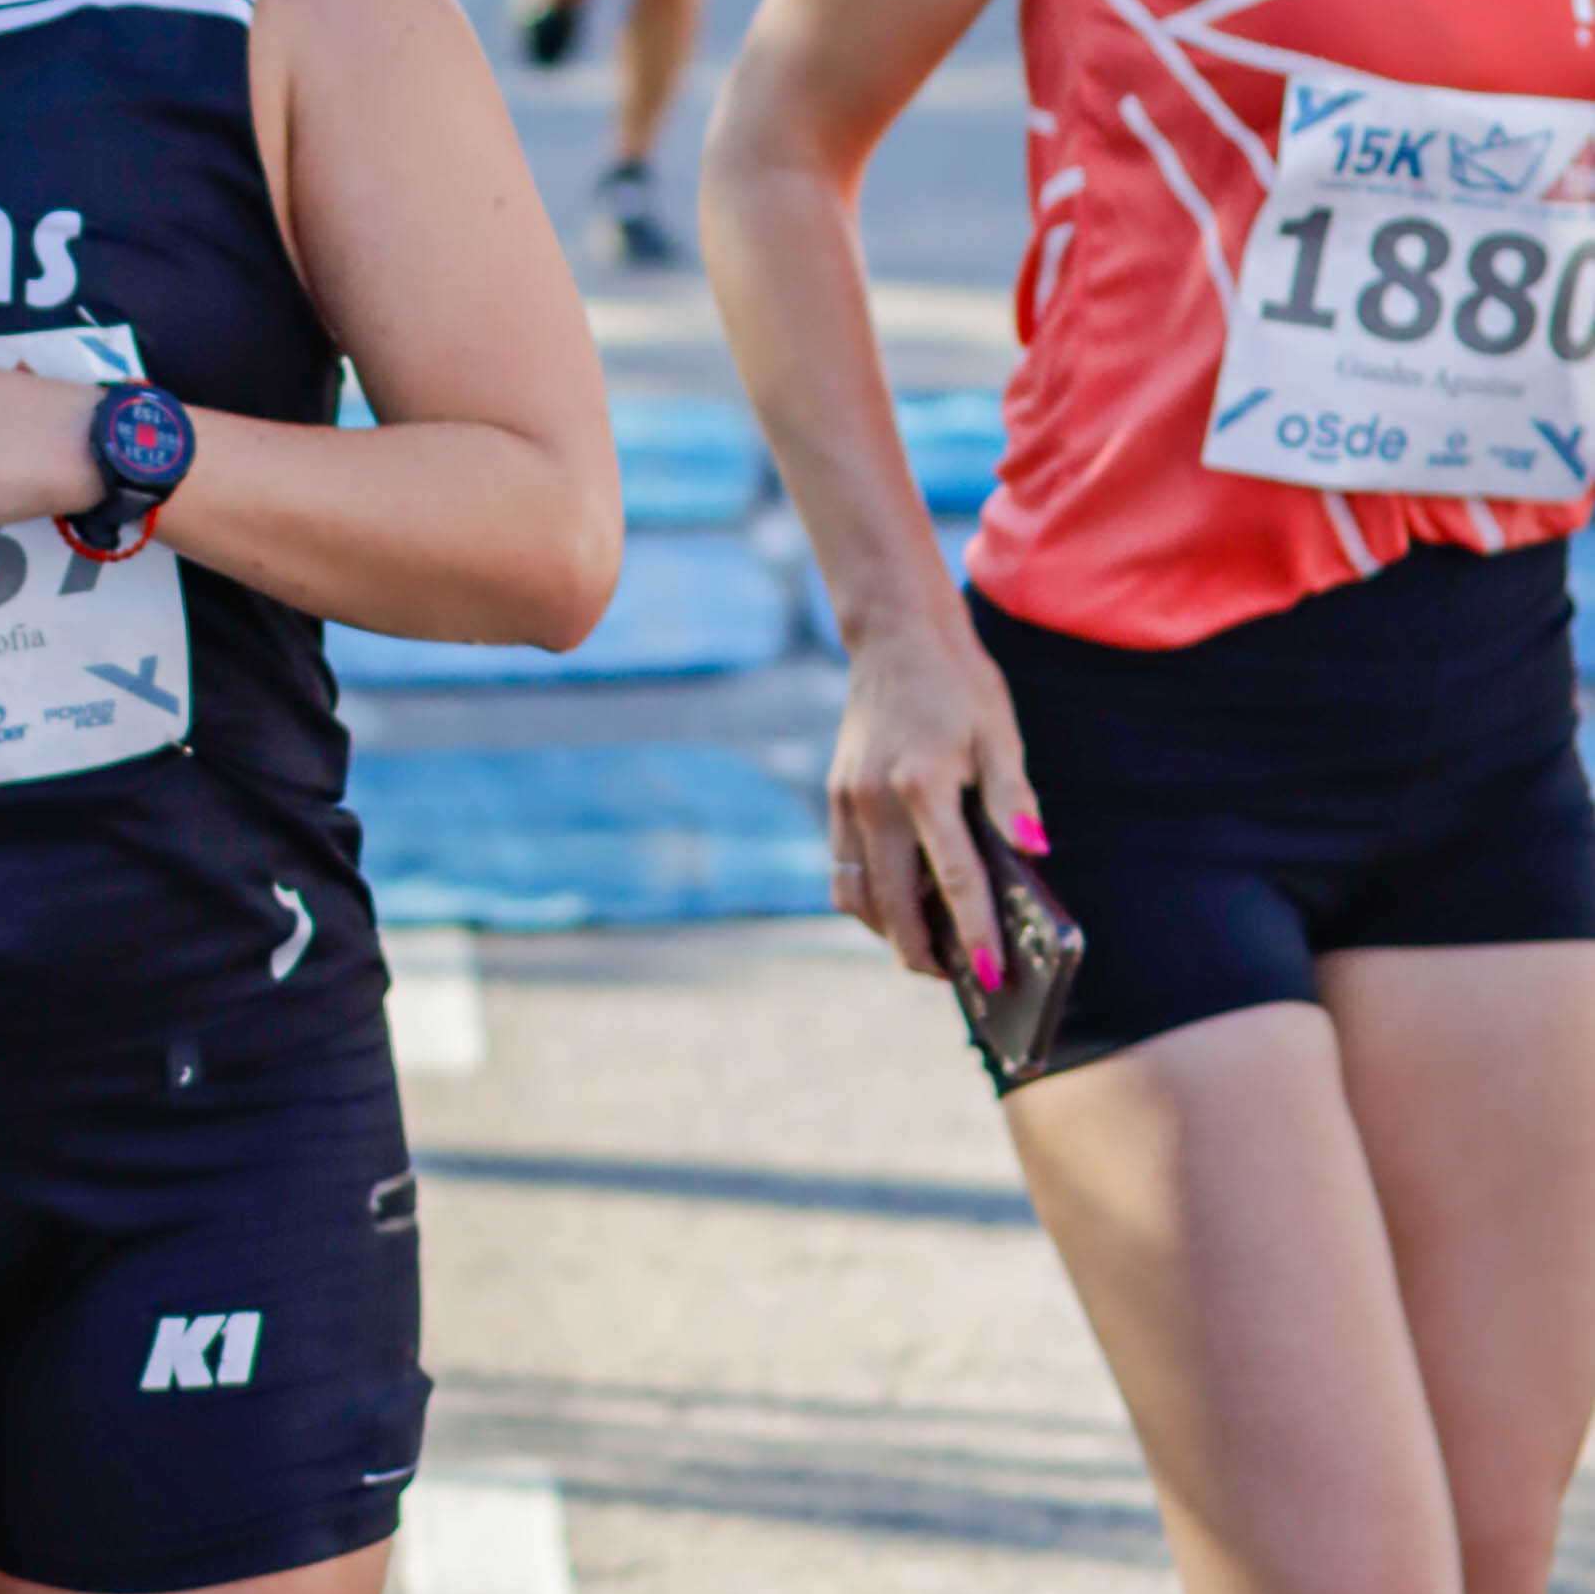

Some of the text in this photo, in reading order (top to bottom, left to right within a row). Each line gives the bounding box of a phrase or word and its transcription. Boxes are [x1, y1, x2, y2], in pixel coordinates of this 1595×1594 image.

[1332, 122, 1438, 180] 15K
[1260, 206, 1595, 361] 1880
[1277, 412, 1408, 462] osde
[139, 1312, 262, 1392] K1
